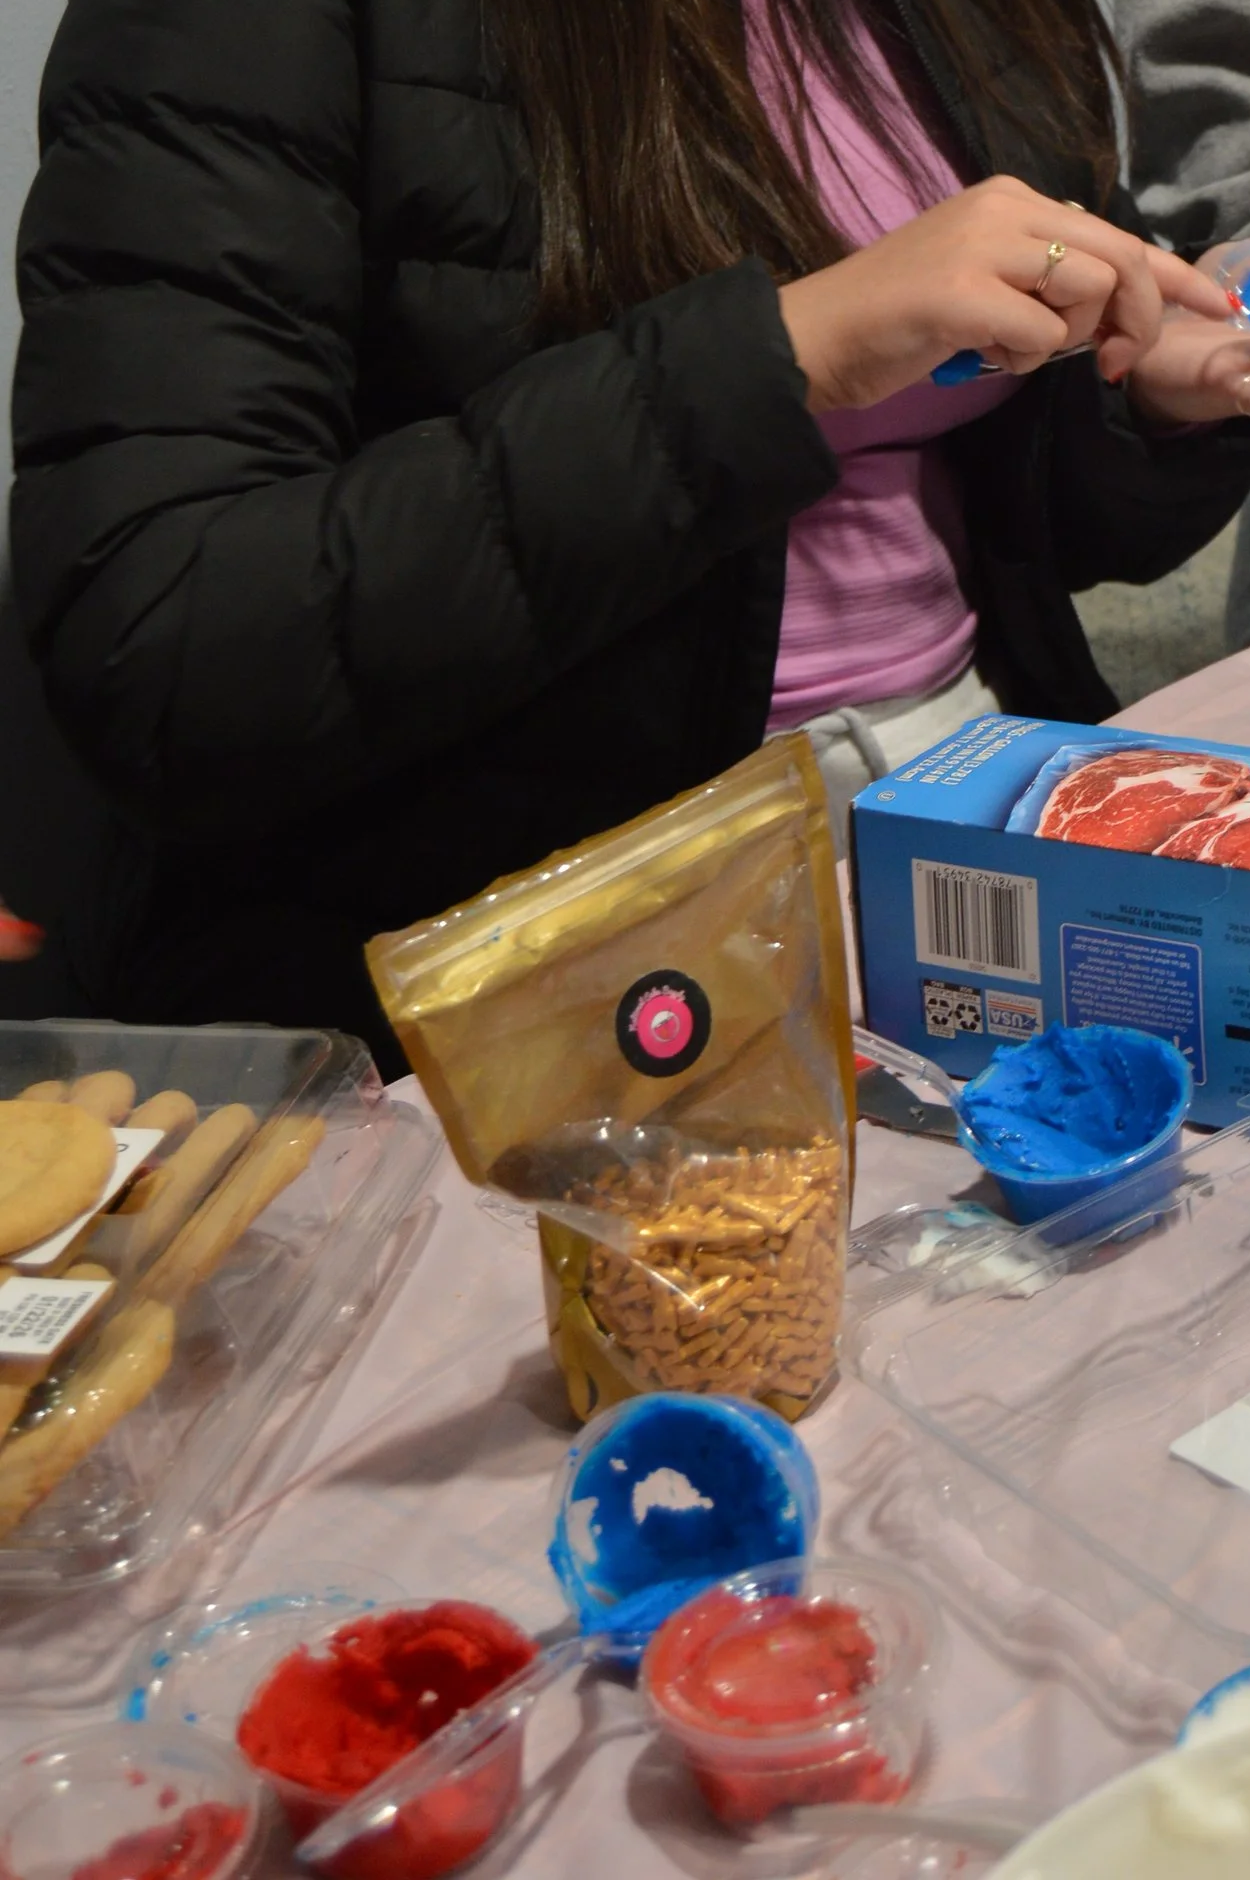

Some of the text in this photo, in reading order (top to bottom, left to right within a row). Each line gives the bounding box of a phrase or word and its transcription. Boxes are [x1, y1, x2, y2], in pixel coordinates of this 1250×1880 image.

[935, 866, 971, 880] 34951
[976, 872, 1012, 888] 78742
[990, 1009, 1021, 1027] USA
